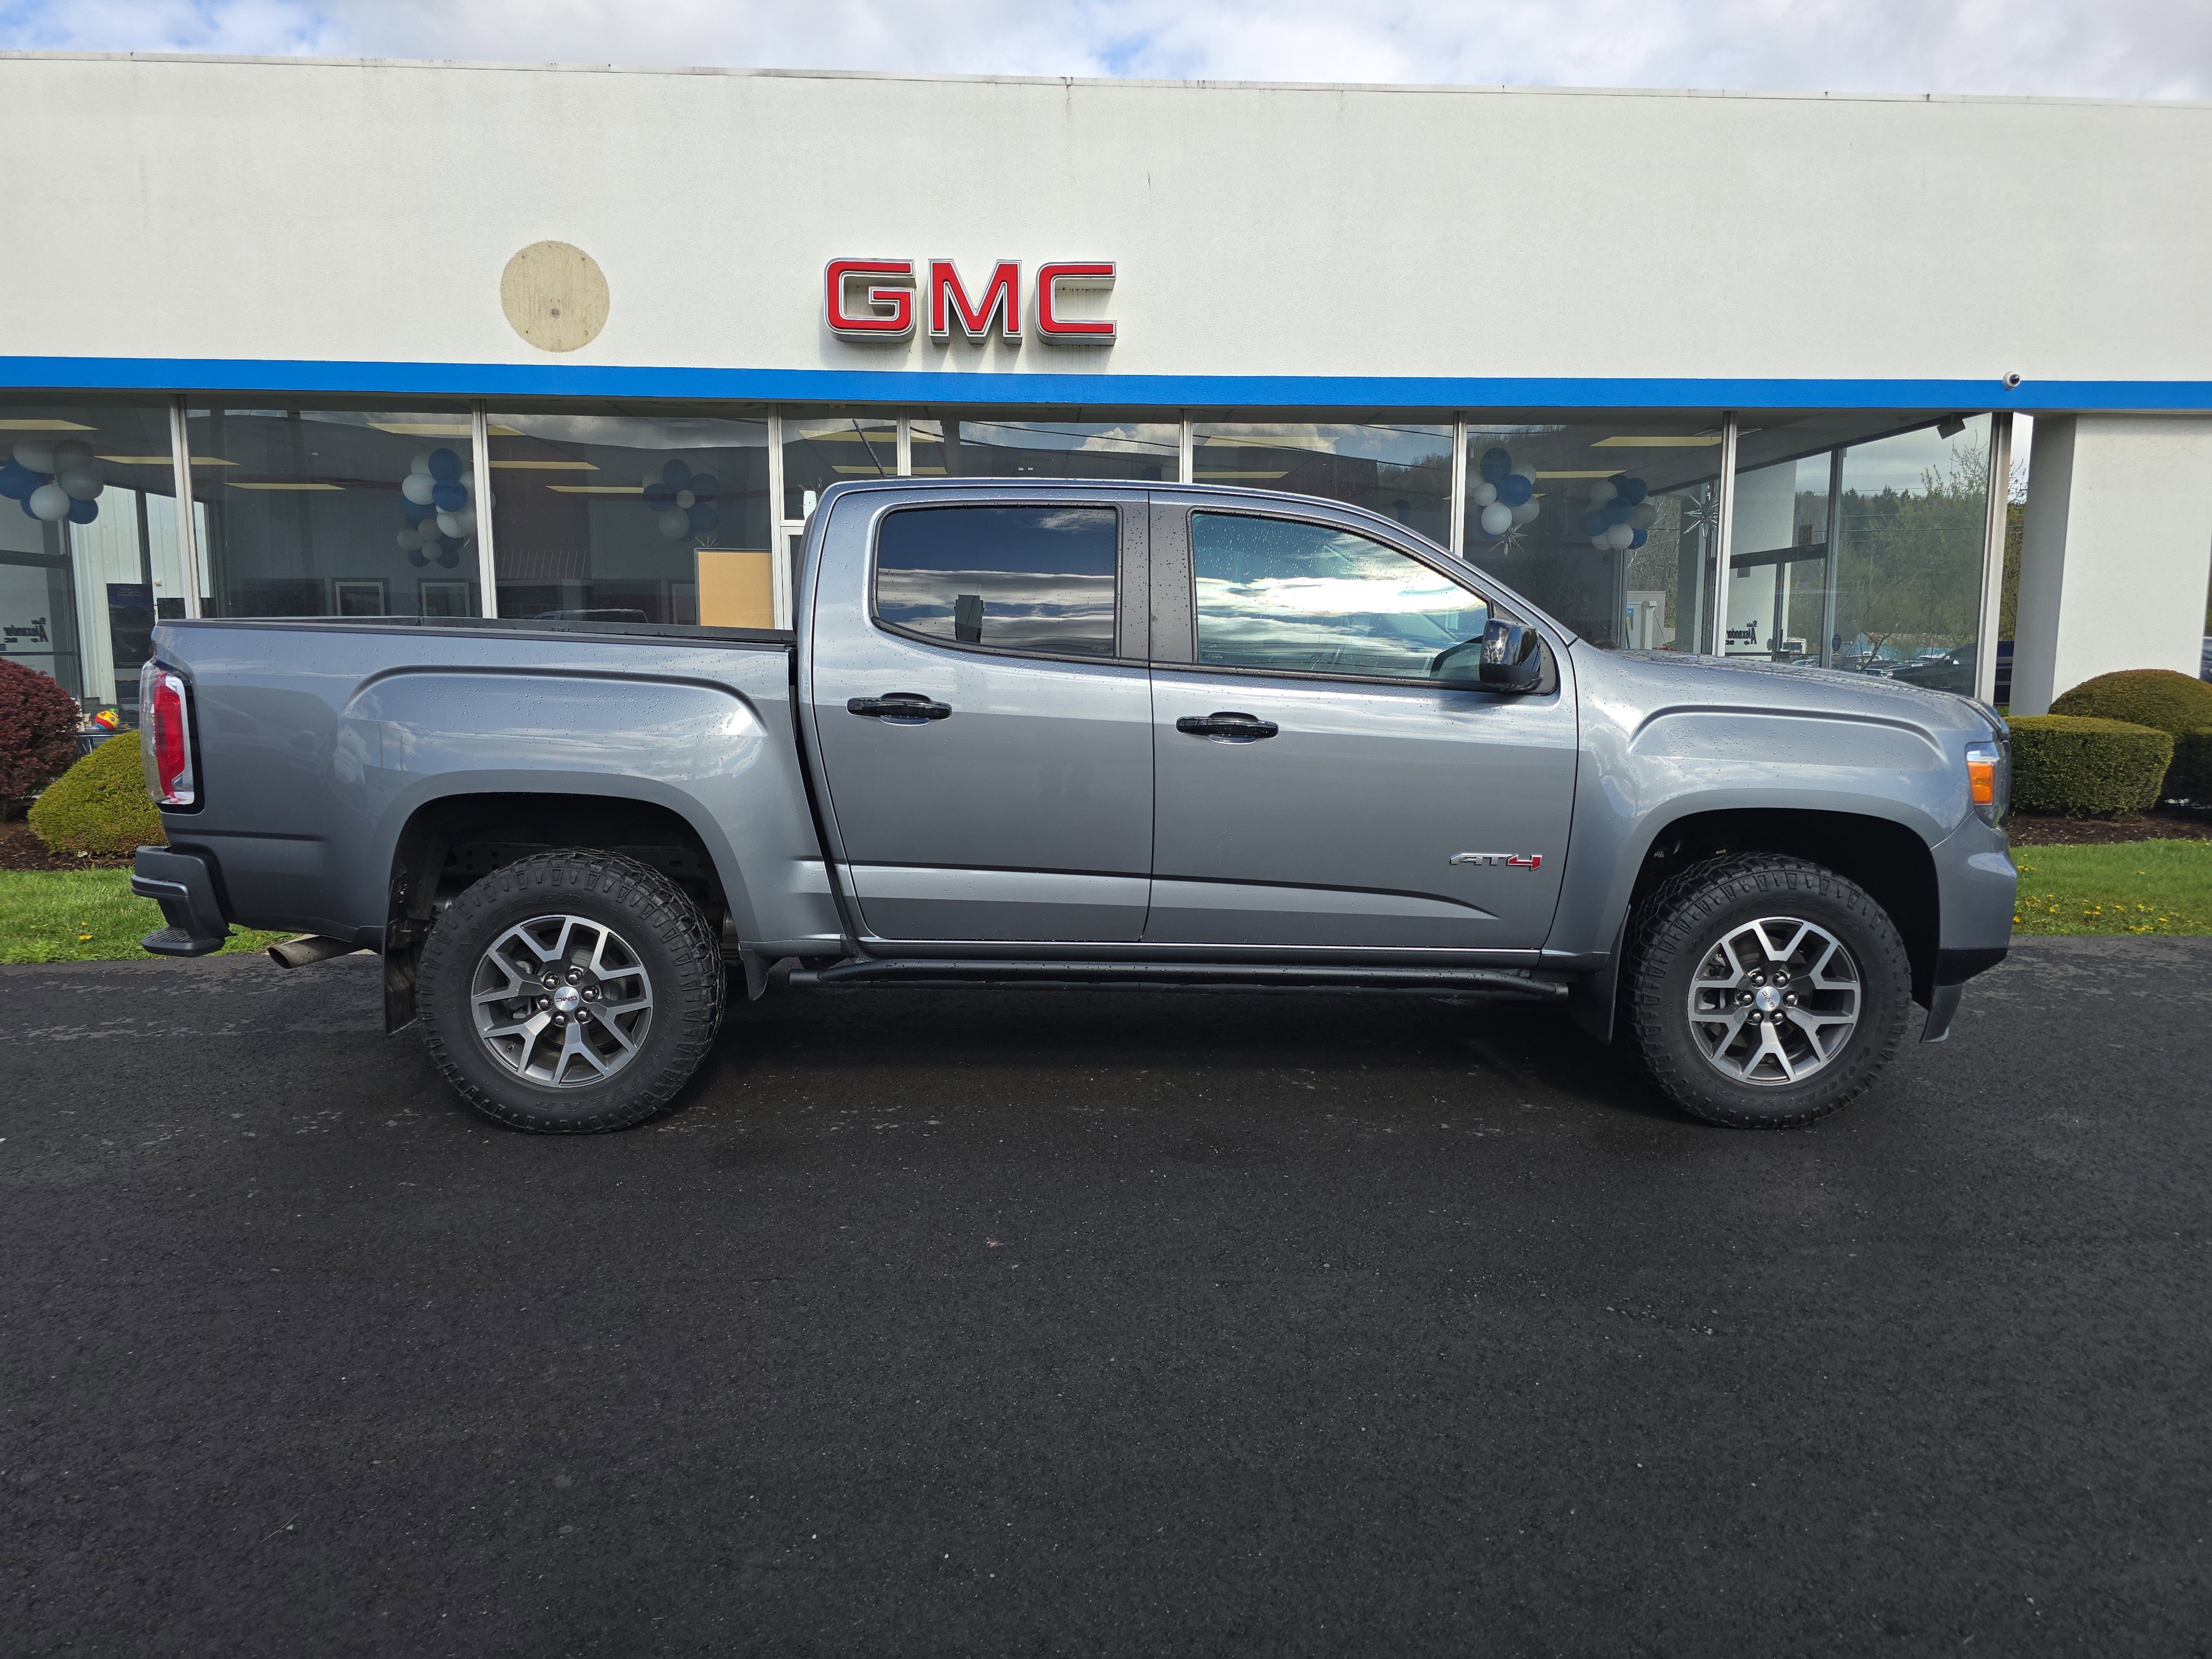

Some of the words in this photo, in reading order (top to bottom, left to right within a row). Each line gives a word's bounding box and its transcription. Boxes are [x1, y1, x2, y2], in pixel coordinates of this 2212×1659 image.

[824, 258, 1117, 342] GMC
[1449, 852, 1542, 871] AT4
[1761, 989, 1775, 1008] GMC
[531, 988, 678, 1113] GOODYEAR
